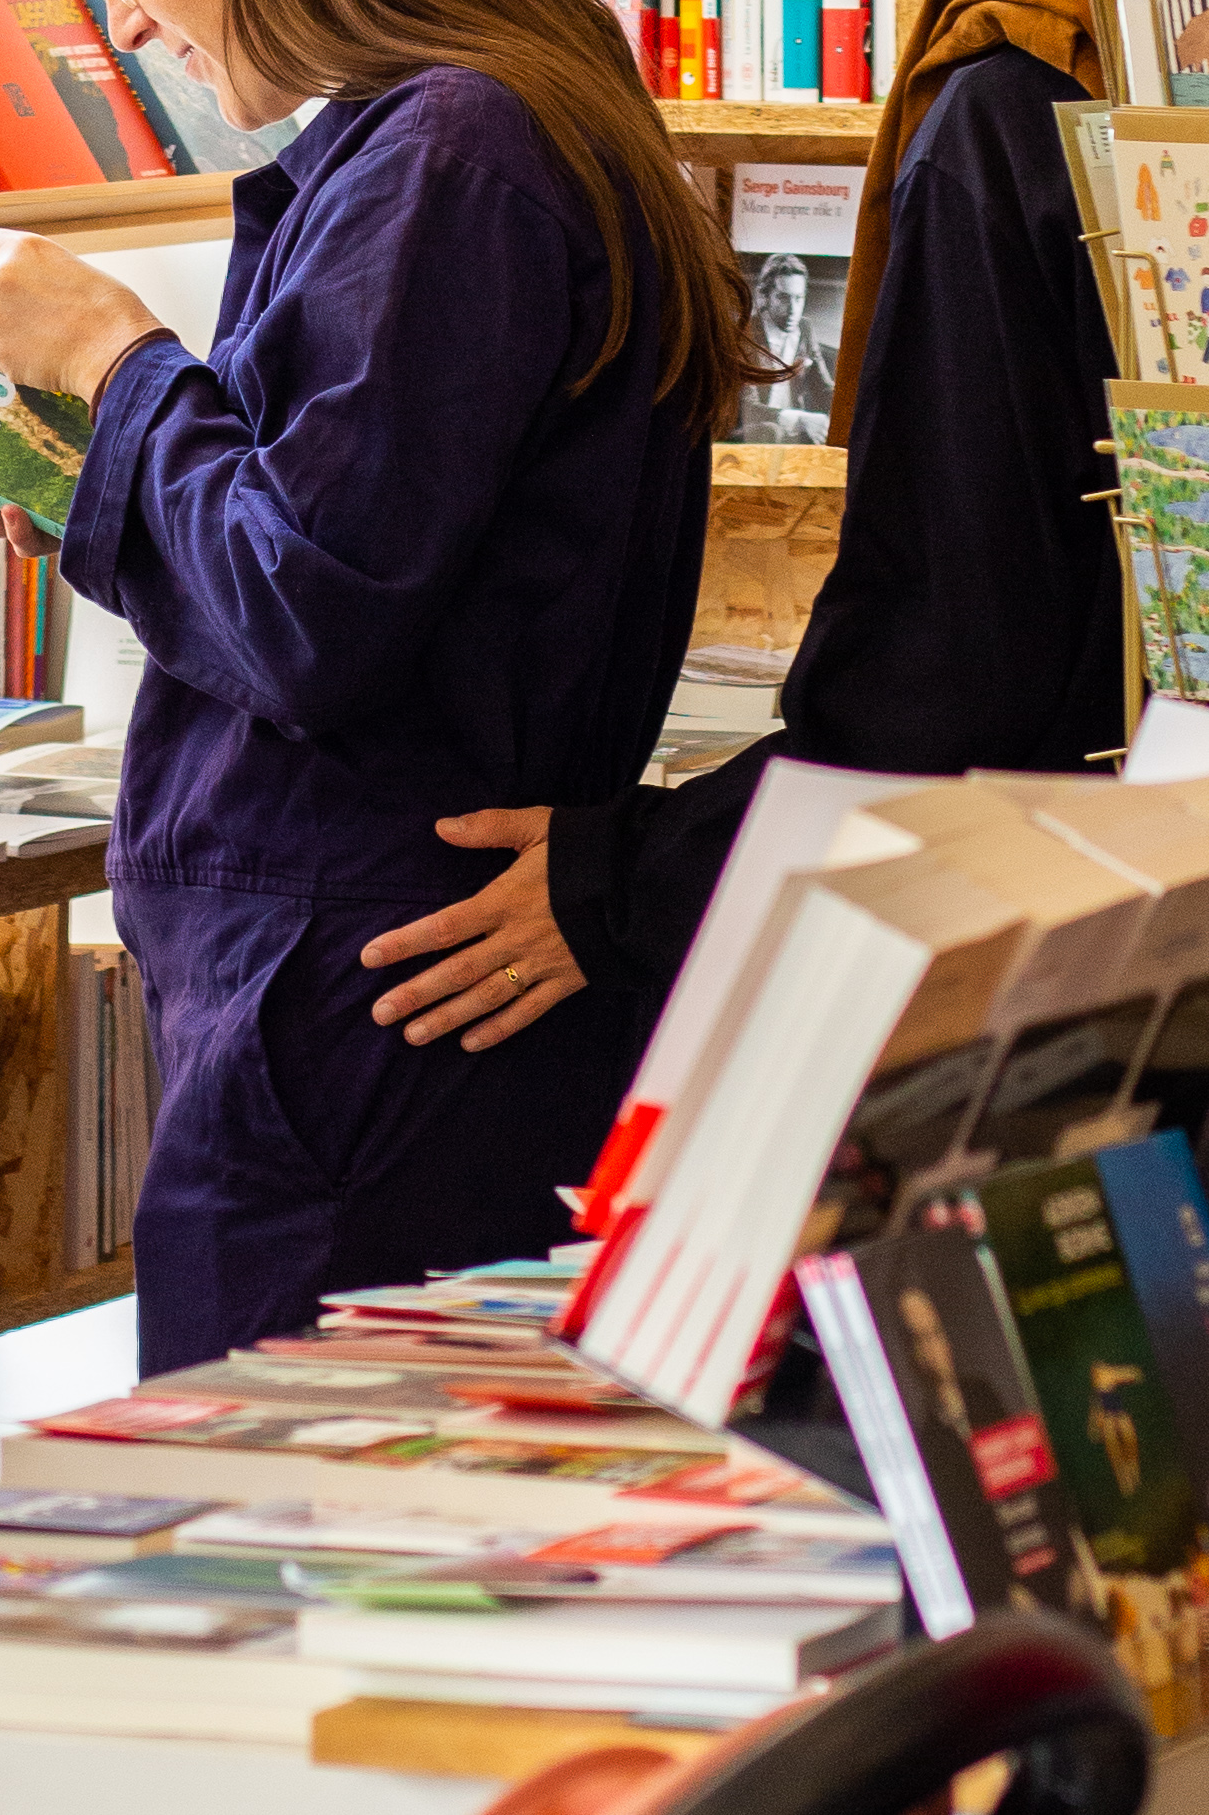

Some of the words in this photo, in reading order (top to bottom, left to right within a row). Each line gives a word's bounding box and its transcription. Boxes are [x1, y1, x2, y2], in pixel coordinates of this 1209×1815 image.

[743, 178, 778, 198] Serge
[783, 179, 850, 200] Gainsbourg
[741, 199, 770, 214] Mon
[773, 206, 810, 219] propre
